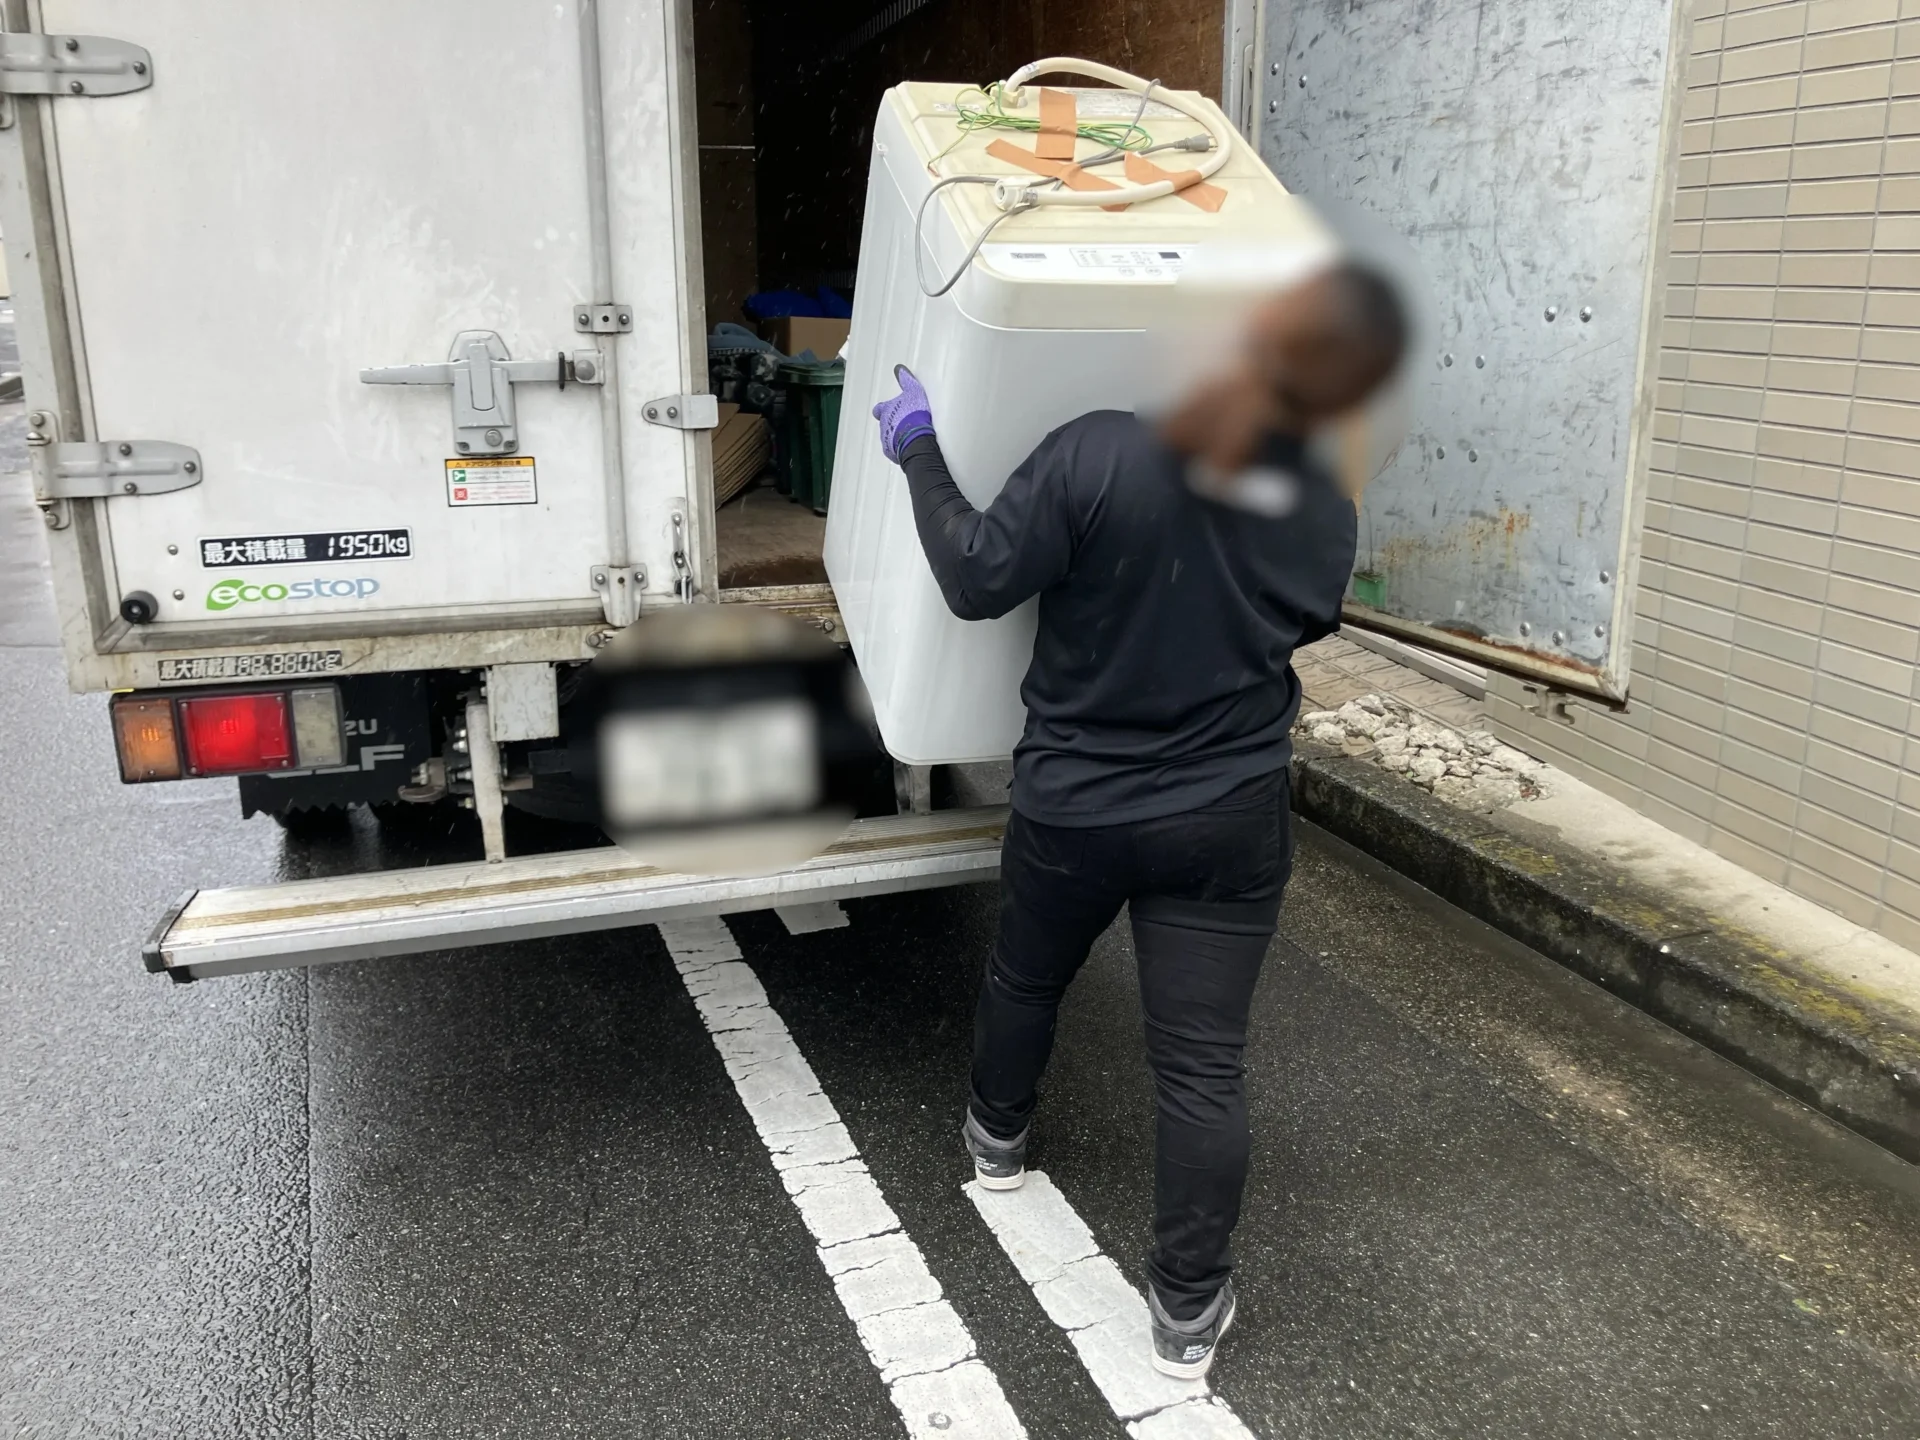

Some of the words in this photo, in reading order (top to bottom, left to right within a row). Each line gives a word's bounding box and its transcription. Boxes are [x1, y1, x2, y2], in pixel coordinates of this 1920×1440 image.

[204, 538, 307, 564] 最大積載量
[328, 533, 407, 557] 1950kg
